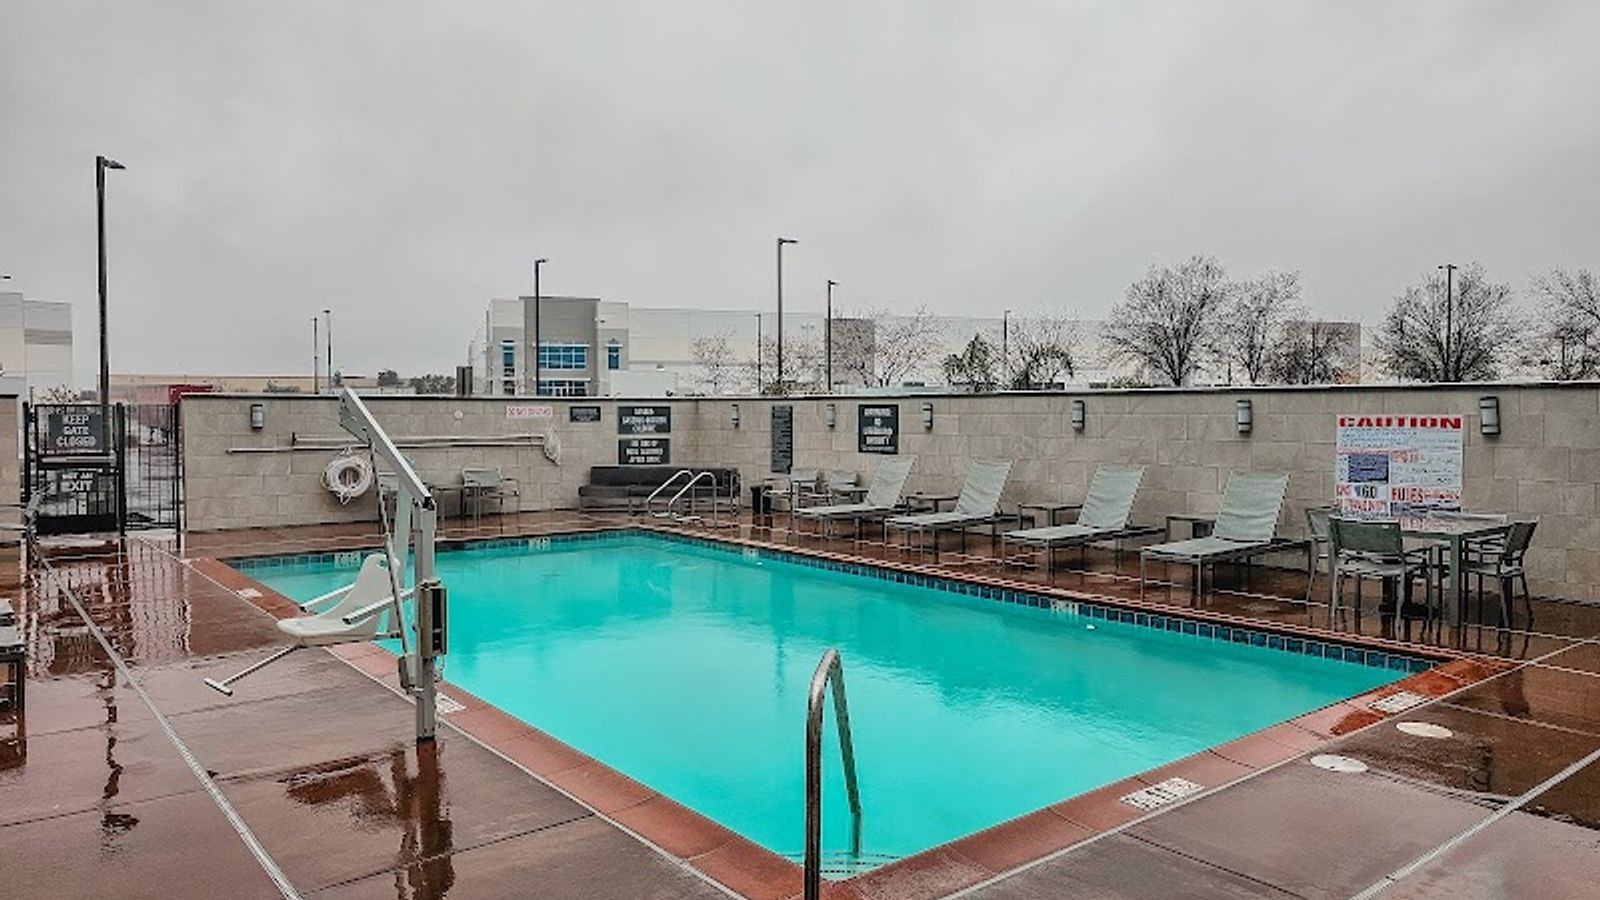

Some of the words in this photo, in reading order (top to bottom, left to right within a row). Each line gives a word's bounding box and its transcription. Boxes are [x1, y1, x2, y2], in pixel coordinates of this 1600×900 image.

[62, 415, 89, 424] KEEP
[1339, 416, 1462, 429] CAUTION
[63, 426, 89, 435] GATE
[56, 436, 96, 447] CLOSED
[60, 480, 93, 492] EXIT
